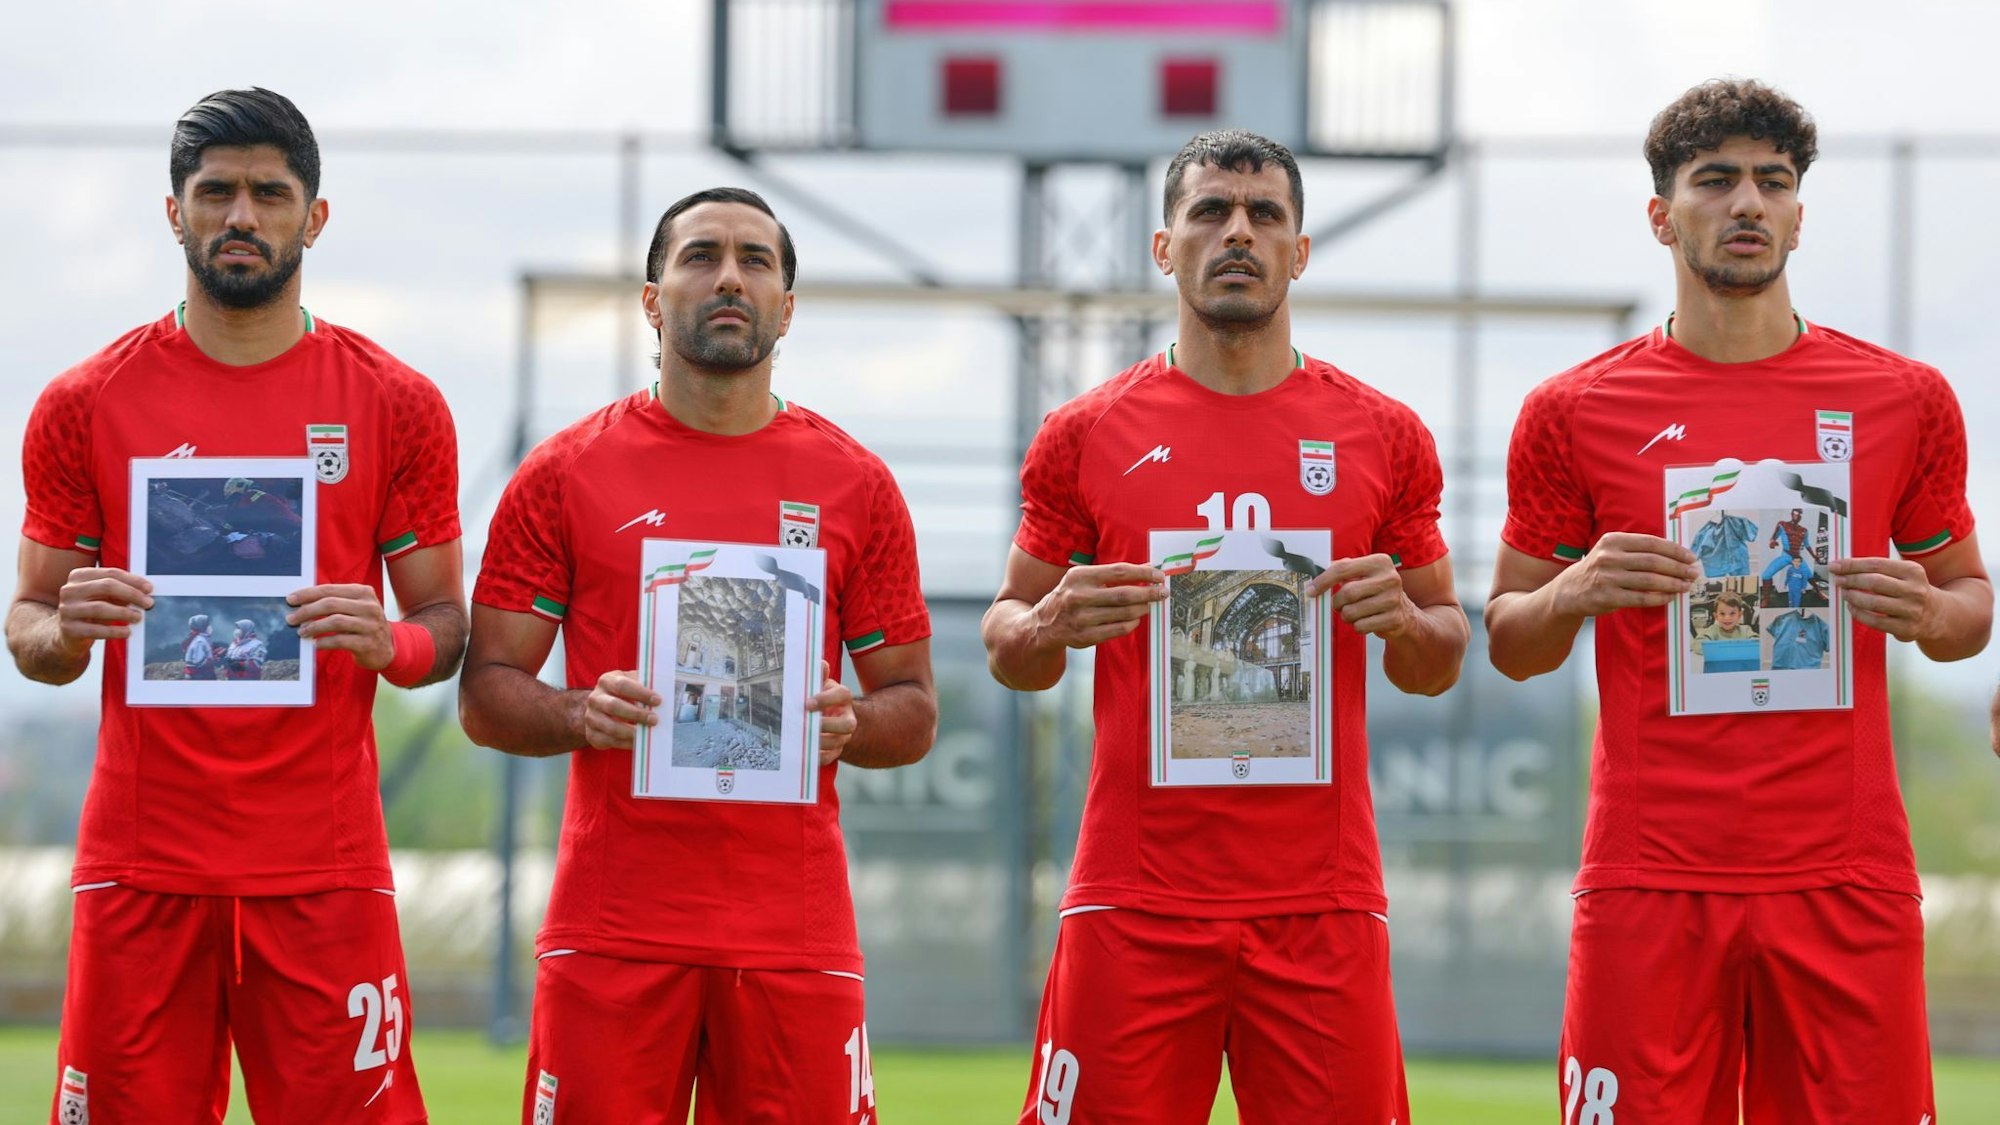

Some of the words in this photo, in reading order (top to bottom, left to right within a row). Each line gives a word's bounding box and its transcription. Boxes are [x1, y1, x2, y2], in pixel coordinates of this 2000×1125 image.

[1369, 738, 1551, 816] NIC
[347, 973, 403, 1072] 25
[845, 1021, 875, 1114] 14
[1037, 1038, 1079, 1125] 19
[1564, 1055, 1619, 1125] 28
